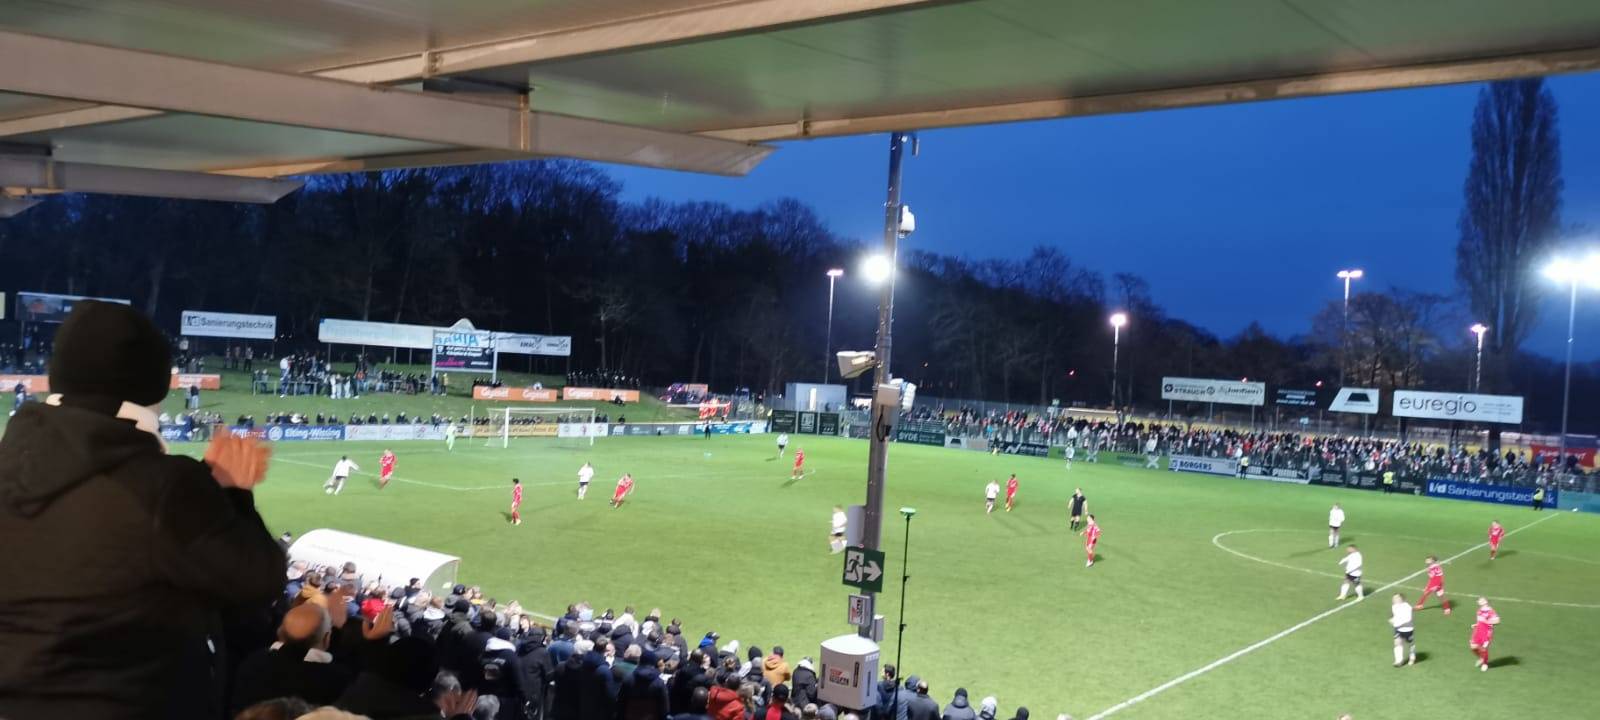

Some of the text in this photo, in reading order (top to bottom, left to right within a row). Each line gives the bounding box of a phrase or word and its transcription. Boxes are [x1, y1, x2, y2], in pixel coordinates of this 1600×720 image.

[201, 317, 273, 330] Sanierungstechnik
[1399, 394, 1477, 416] euregio
[1179, 460, 1212, 471] BORGERS
[1447, 484, 1555, 504] Sanierungstecik
